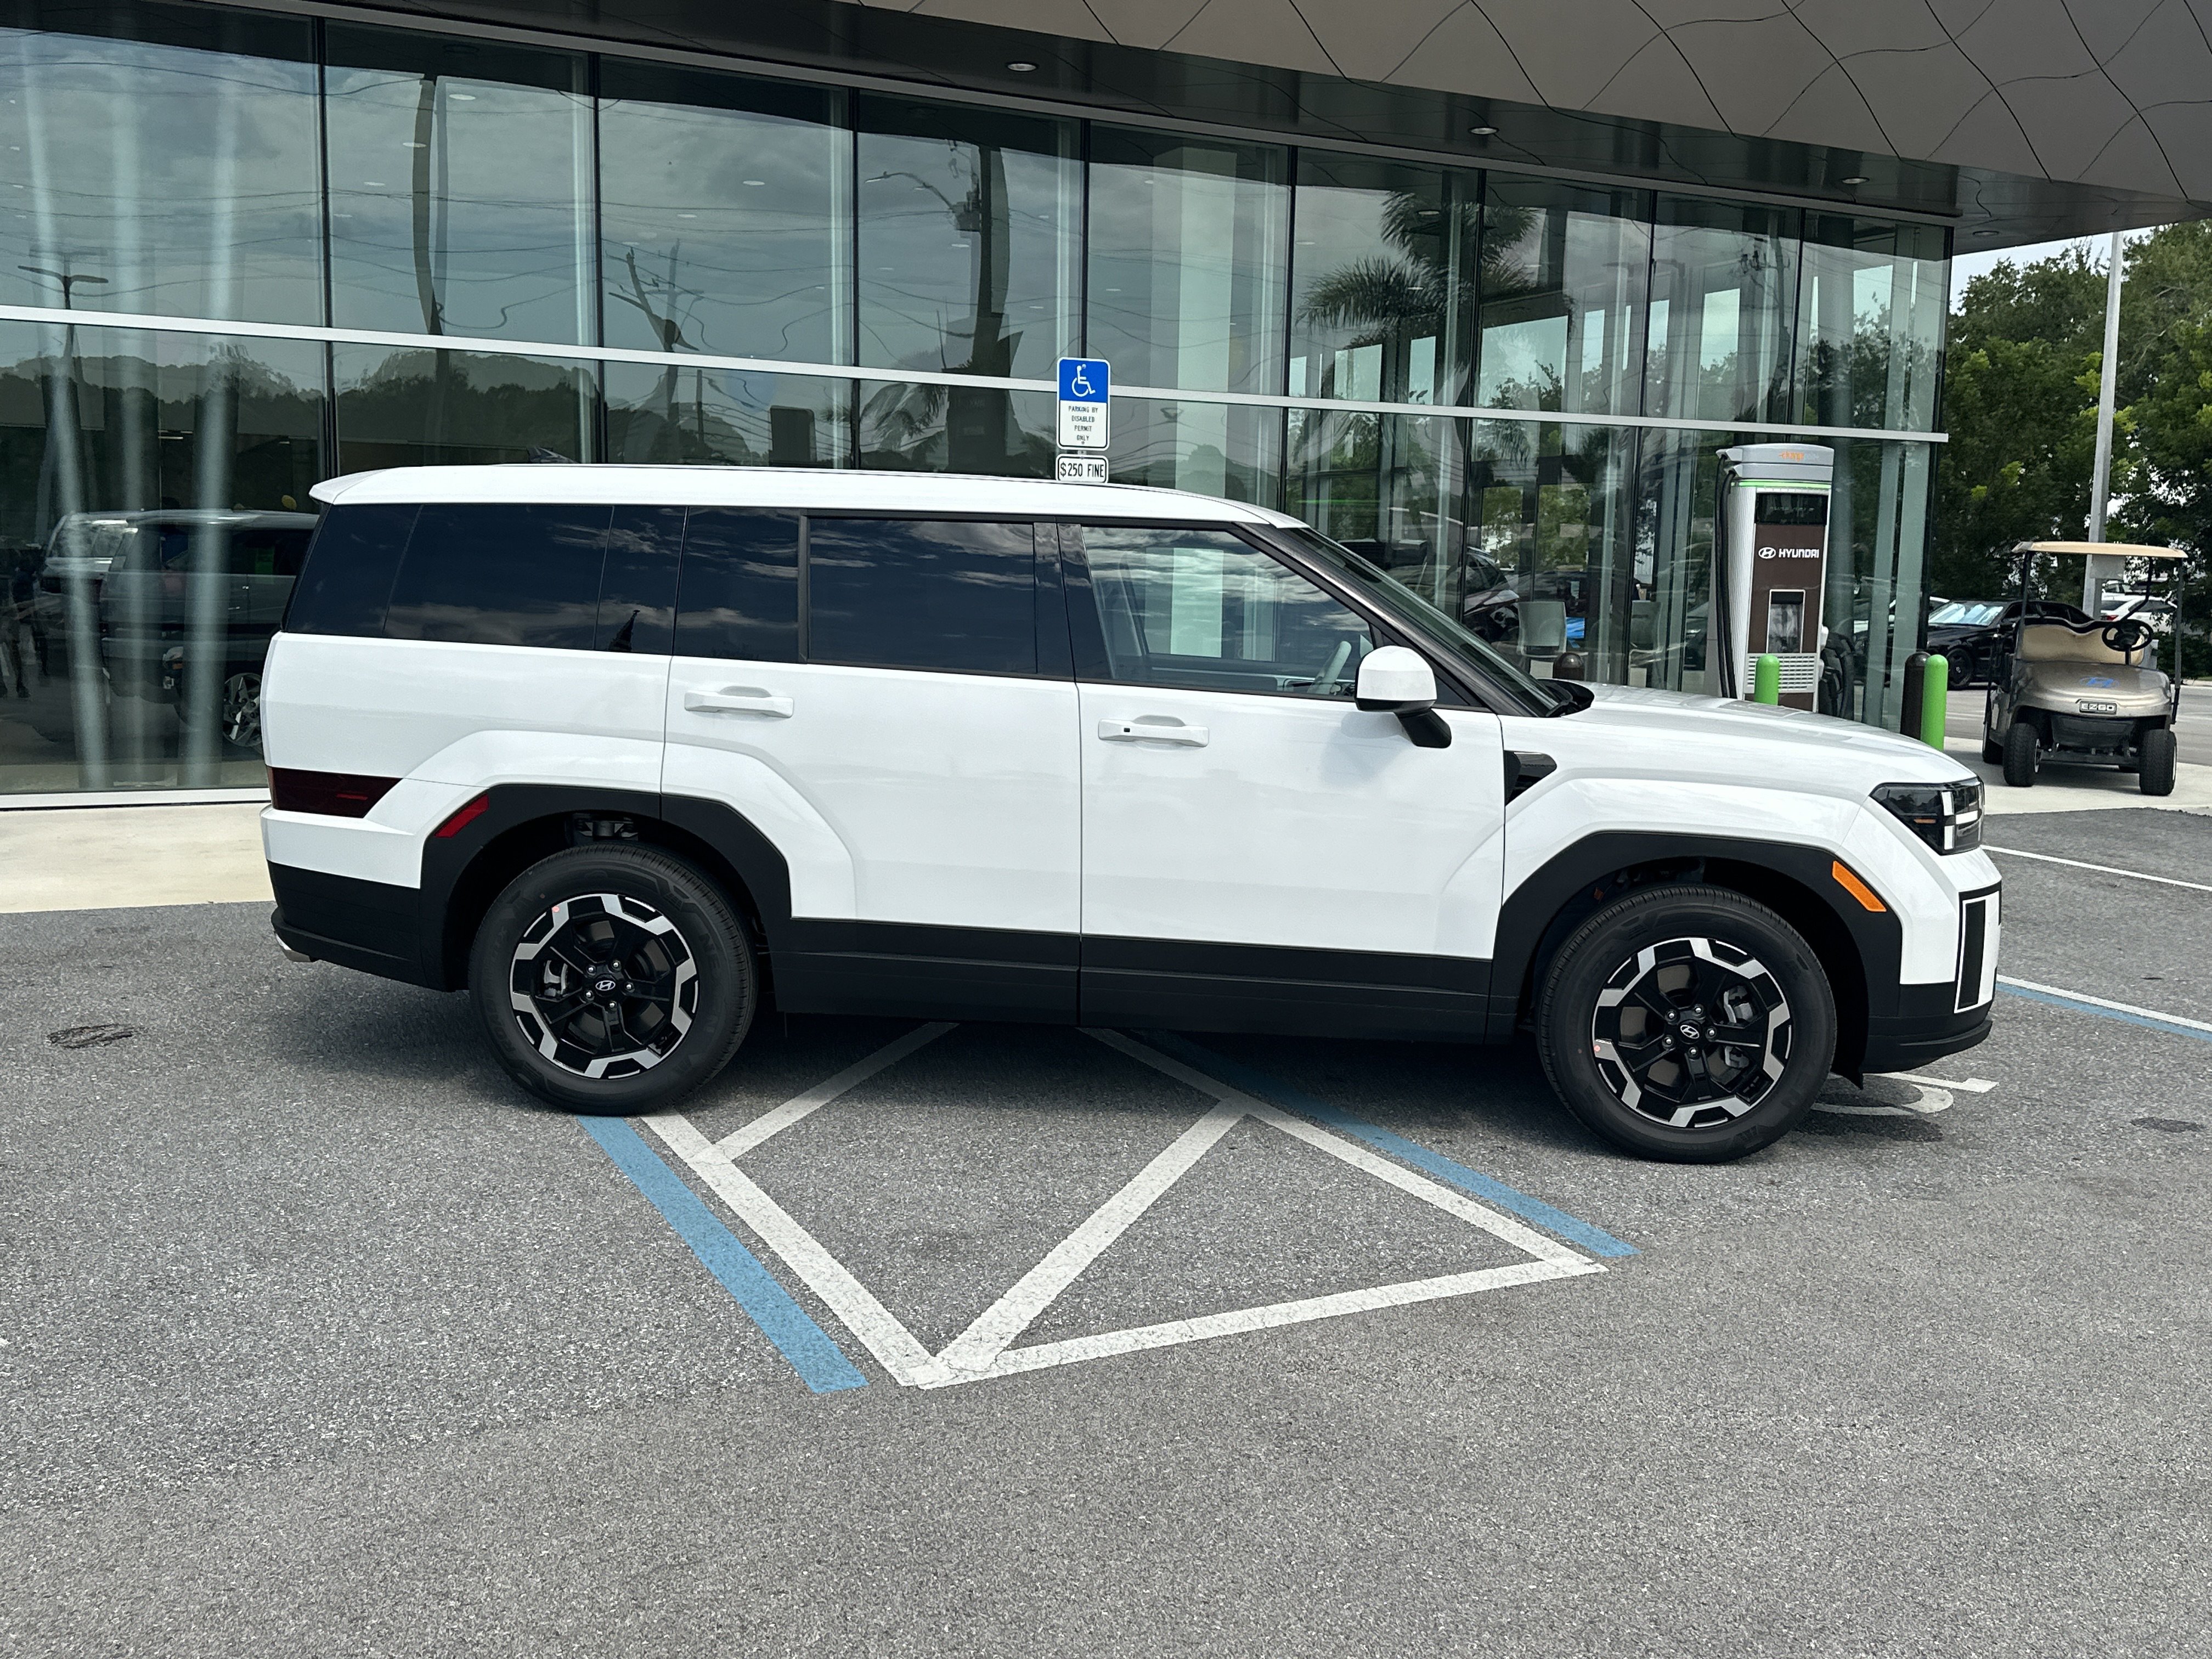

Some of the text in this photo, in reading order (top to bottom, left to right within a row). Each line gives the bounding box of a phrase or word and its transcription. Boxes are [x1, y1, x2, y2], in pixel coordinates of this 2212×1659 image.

[1060, 461, 1104, 478] $250 FINE
[1778, 548, 1819, 558] HYUNDAI
